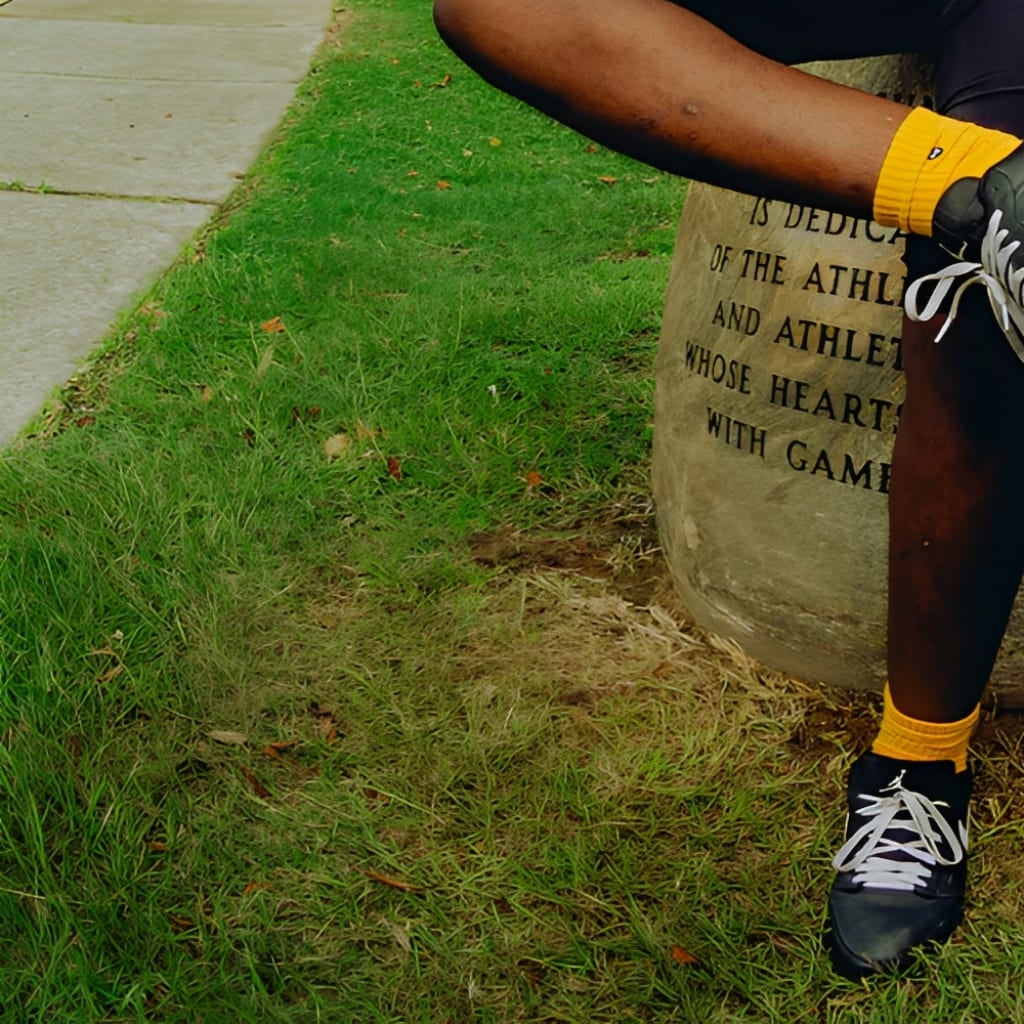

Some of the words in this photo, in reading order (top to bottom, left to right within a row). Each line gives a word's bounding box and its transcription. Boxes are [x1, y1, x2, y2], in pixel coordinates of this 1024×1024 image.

[750, 197, 773, 227] IS
[710, 243, 733, 273] OF
[741, 249, 787, 285] THE
[801, 262, 906, 308] ATHL
[712, 301, 761, 337] AND
[685, 340, 751, 395] WHOSE
[770, 374, 904, 434] HEART
[706, 407, 767, 458] WITH
